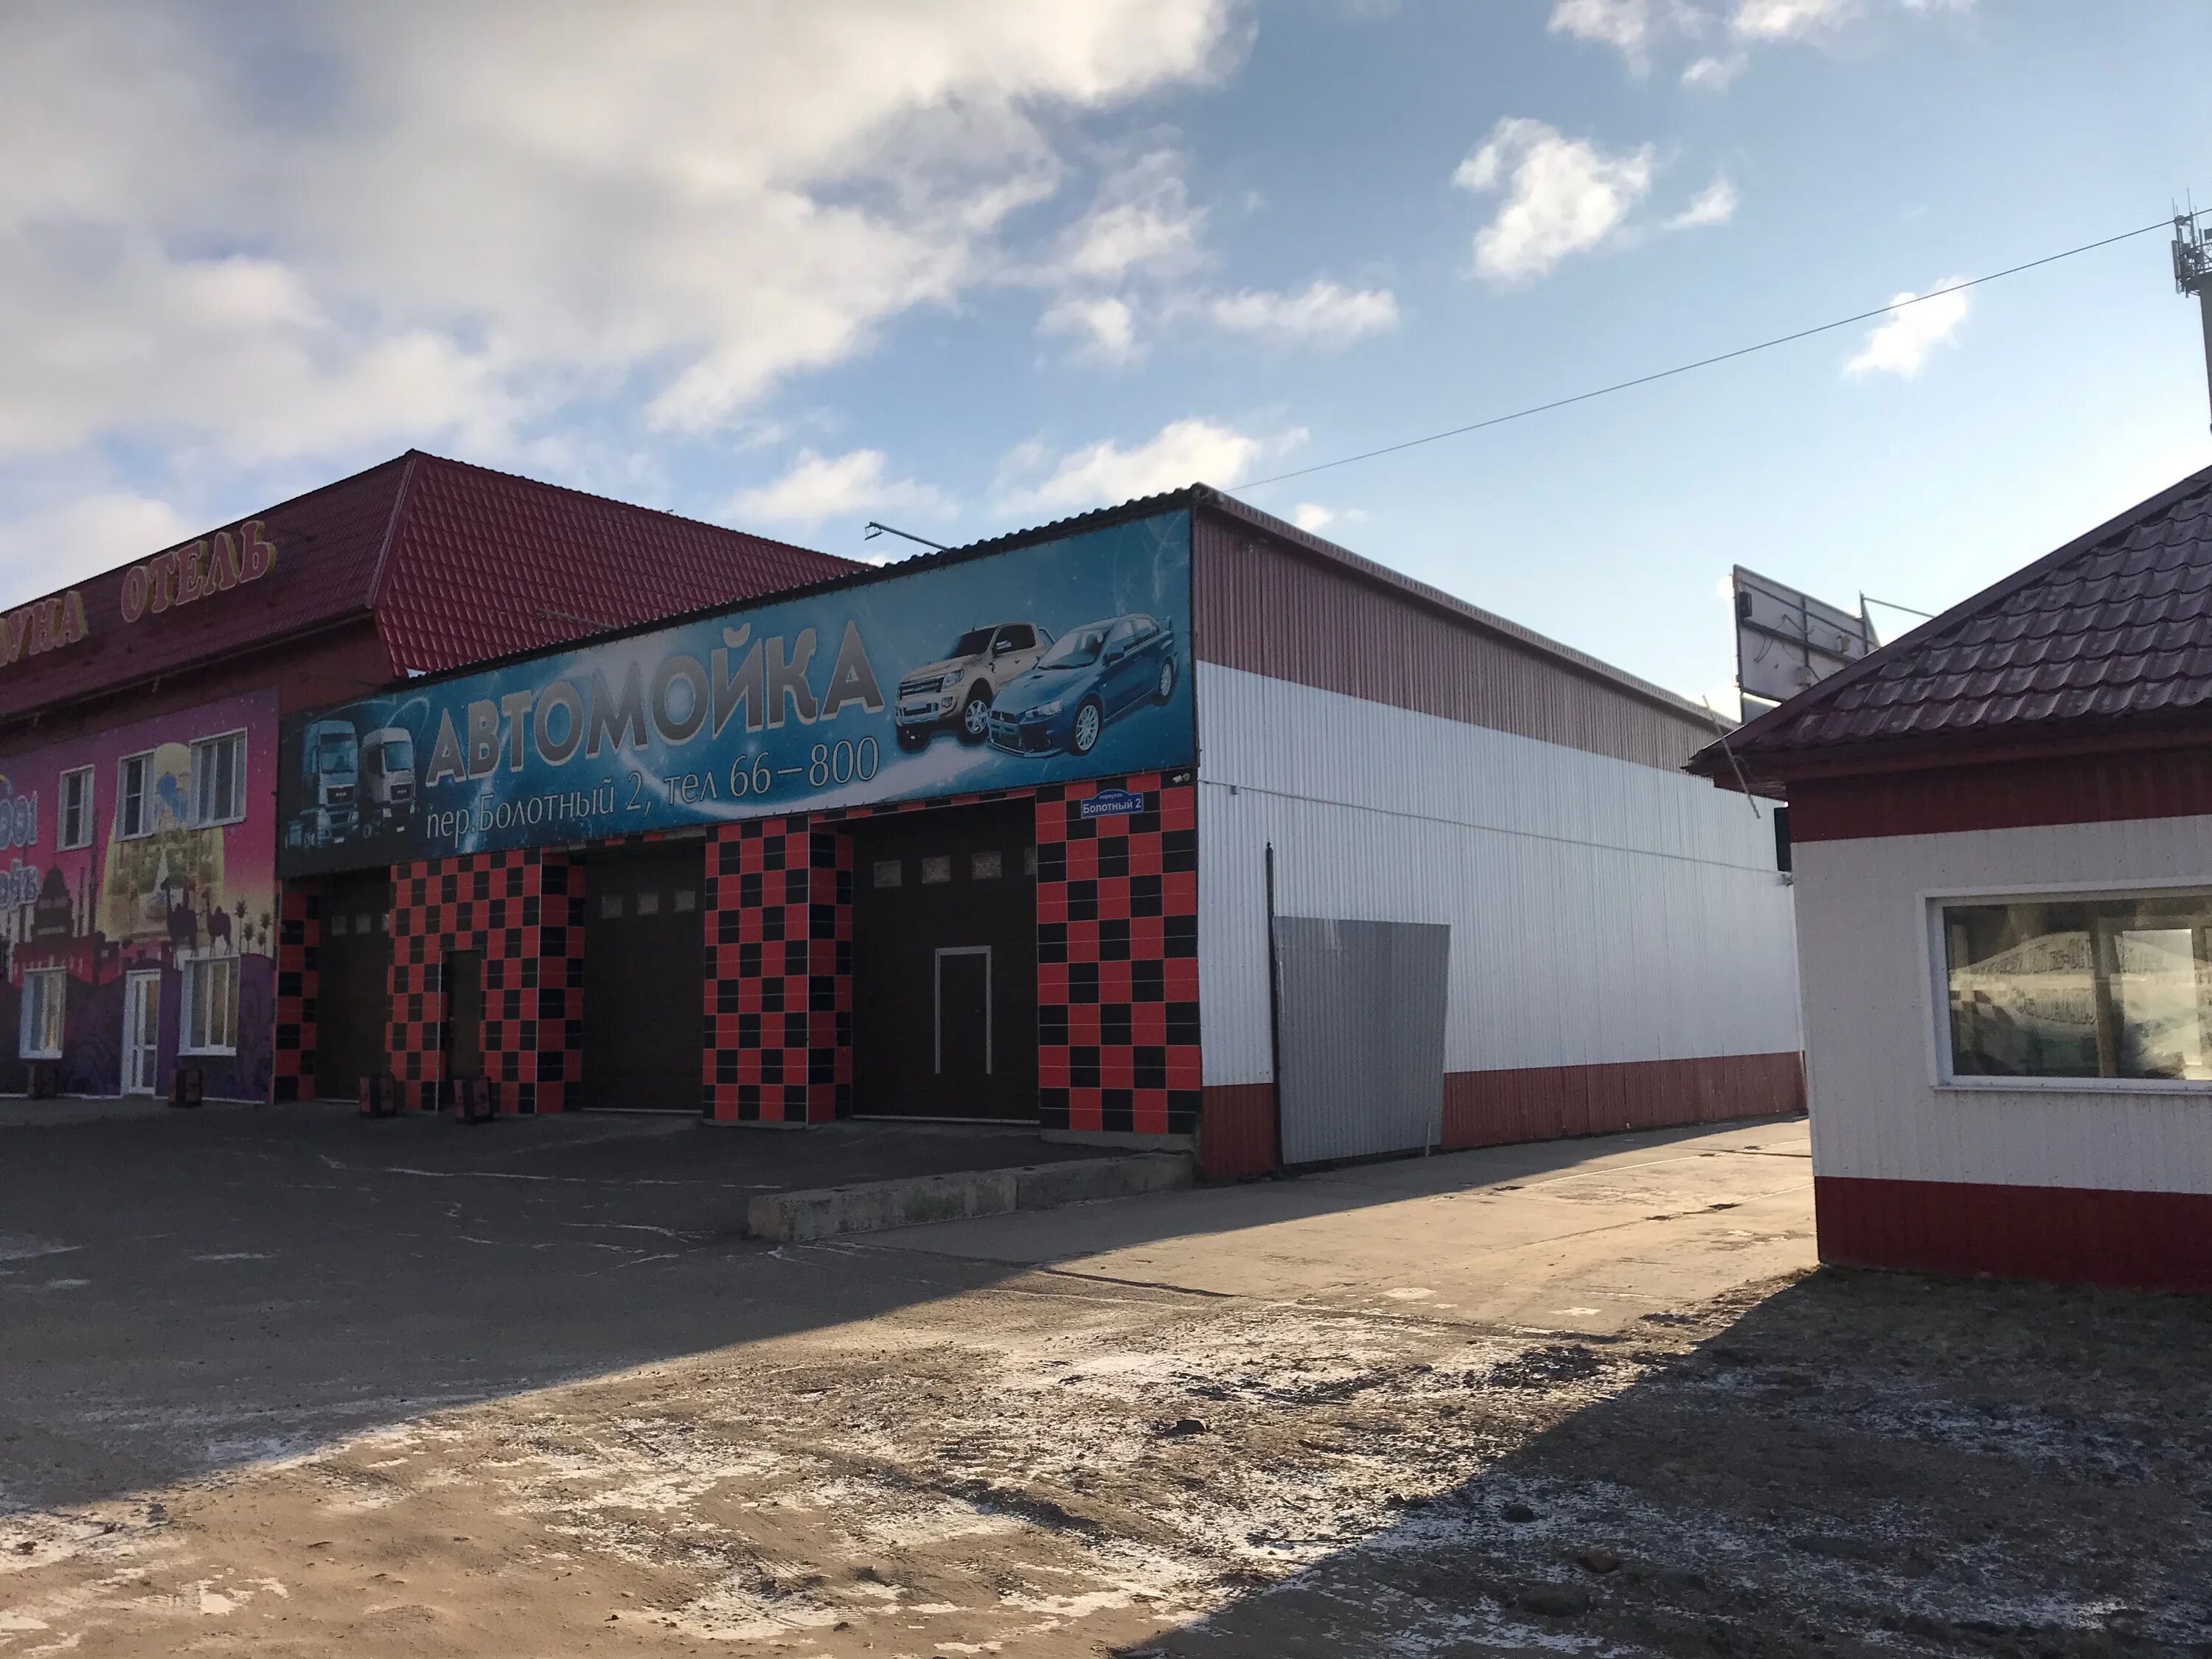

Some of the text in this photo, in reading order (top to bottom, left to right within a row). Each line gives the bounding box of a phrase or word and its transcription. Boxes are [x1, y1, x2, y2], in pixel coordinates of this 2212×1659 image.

[120, 520, 277, 623] ОТЕЛЬ
[425, 619, 886, 787] АВТОМОЙКА
[664, 768, 718, 806] тел
[1083, 799, 1141, 813] Болотный 2
